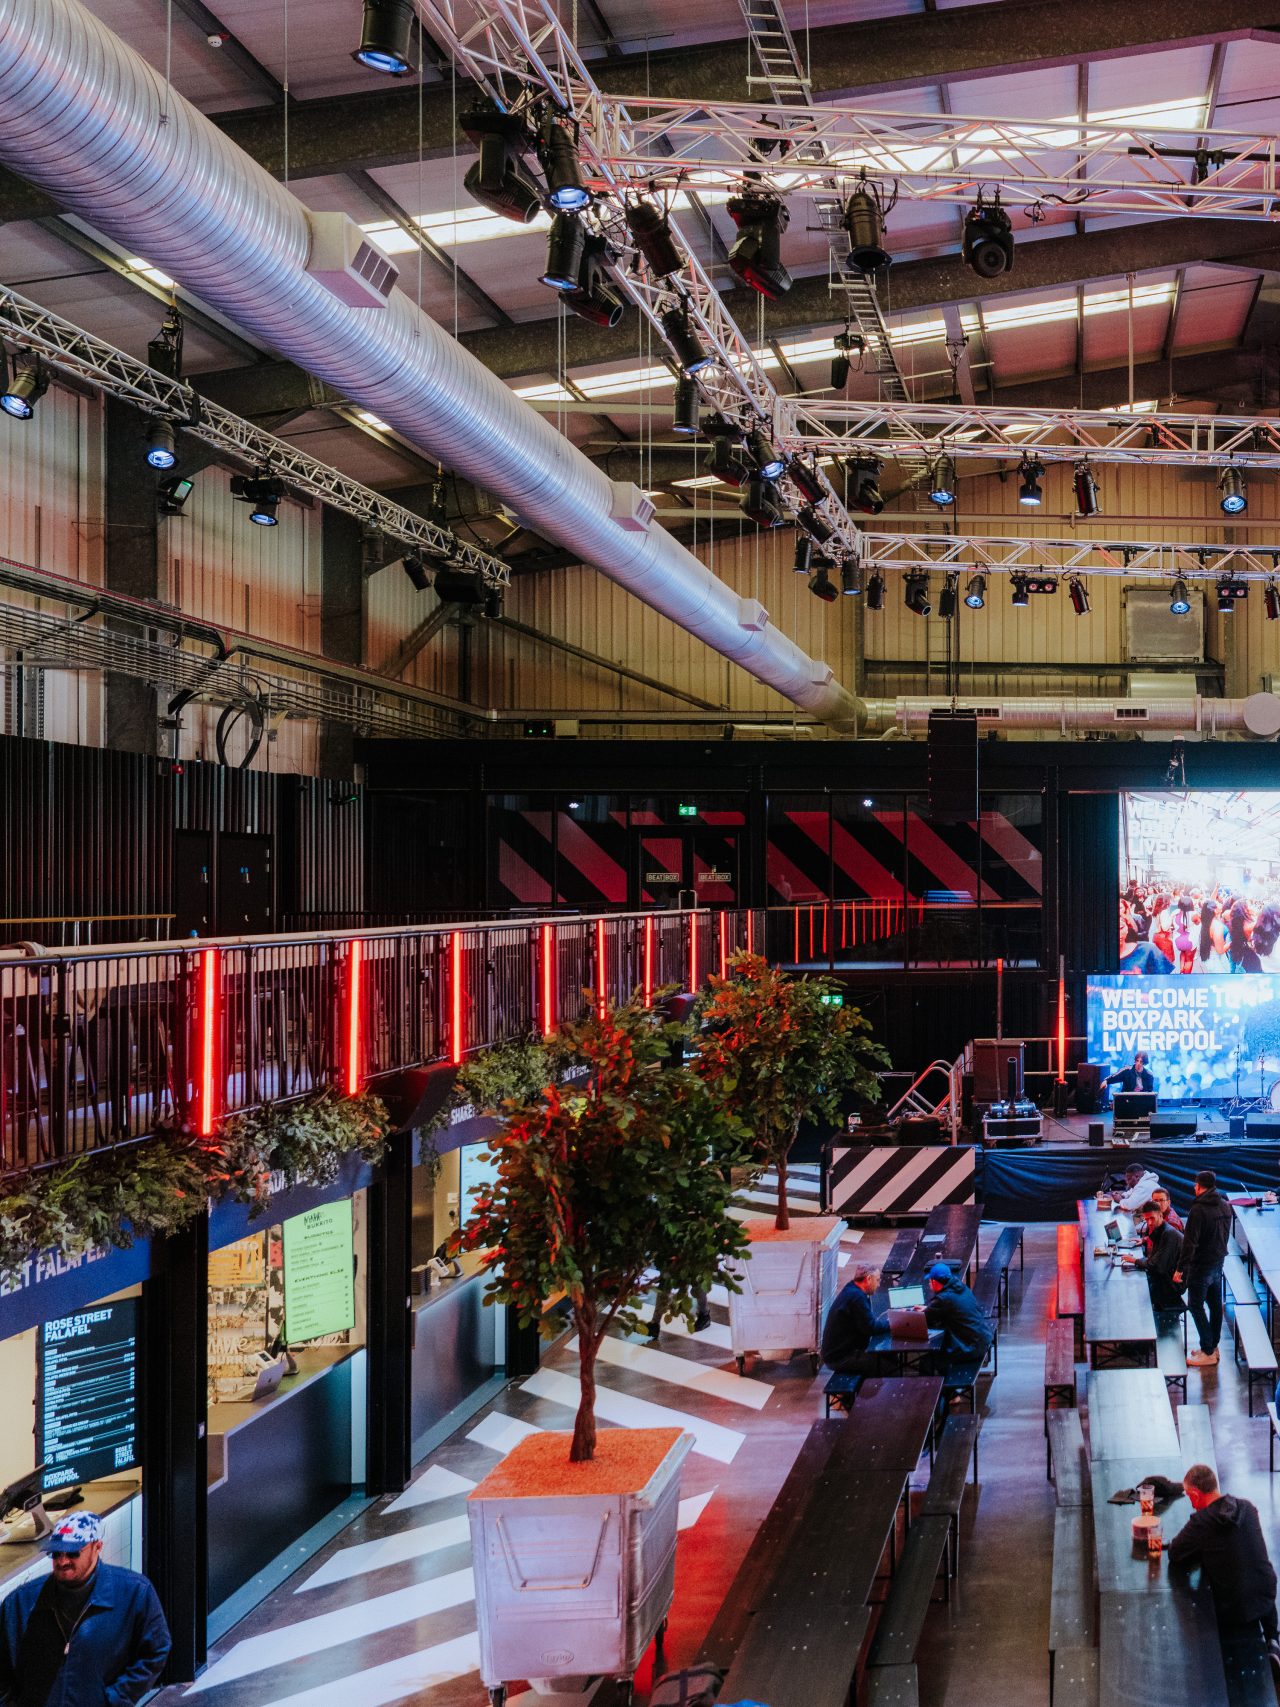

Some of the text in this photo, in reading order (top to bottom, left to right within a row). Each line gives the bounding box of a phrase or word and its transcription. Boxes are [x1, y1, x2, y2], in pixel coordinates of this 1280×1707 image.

[1101, 988, 1208, 1009] WELCOME
[1103, 1009, 1204, 1031] BOXPARK
[1103, 1030, 1223, 1052] LIVERPOOL
[45, 1308, 113, 1332] ROSE STREET
[45, 1324, 91, 1343] FALAFEL
